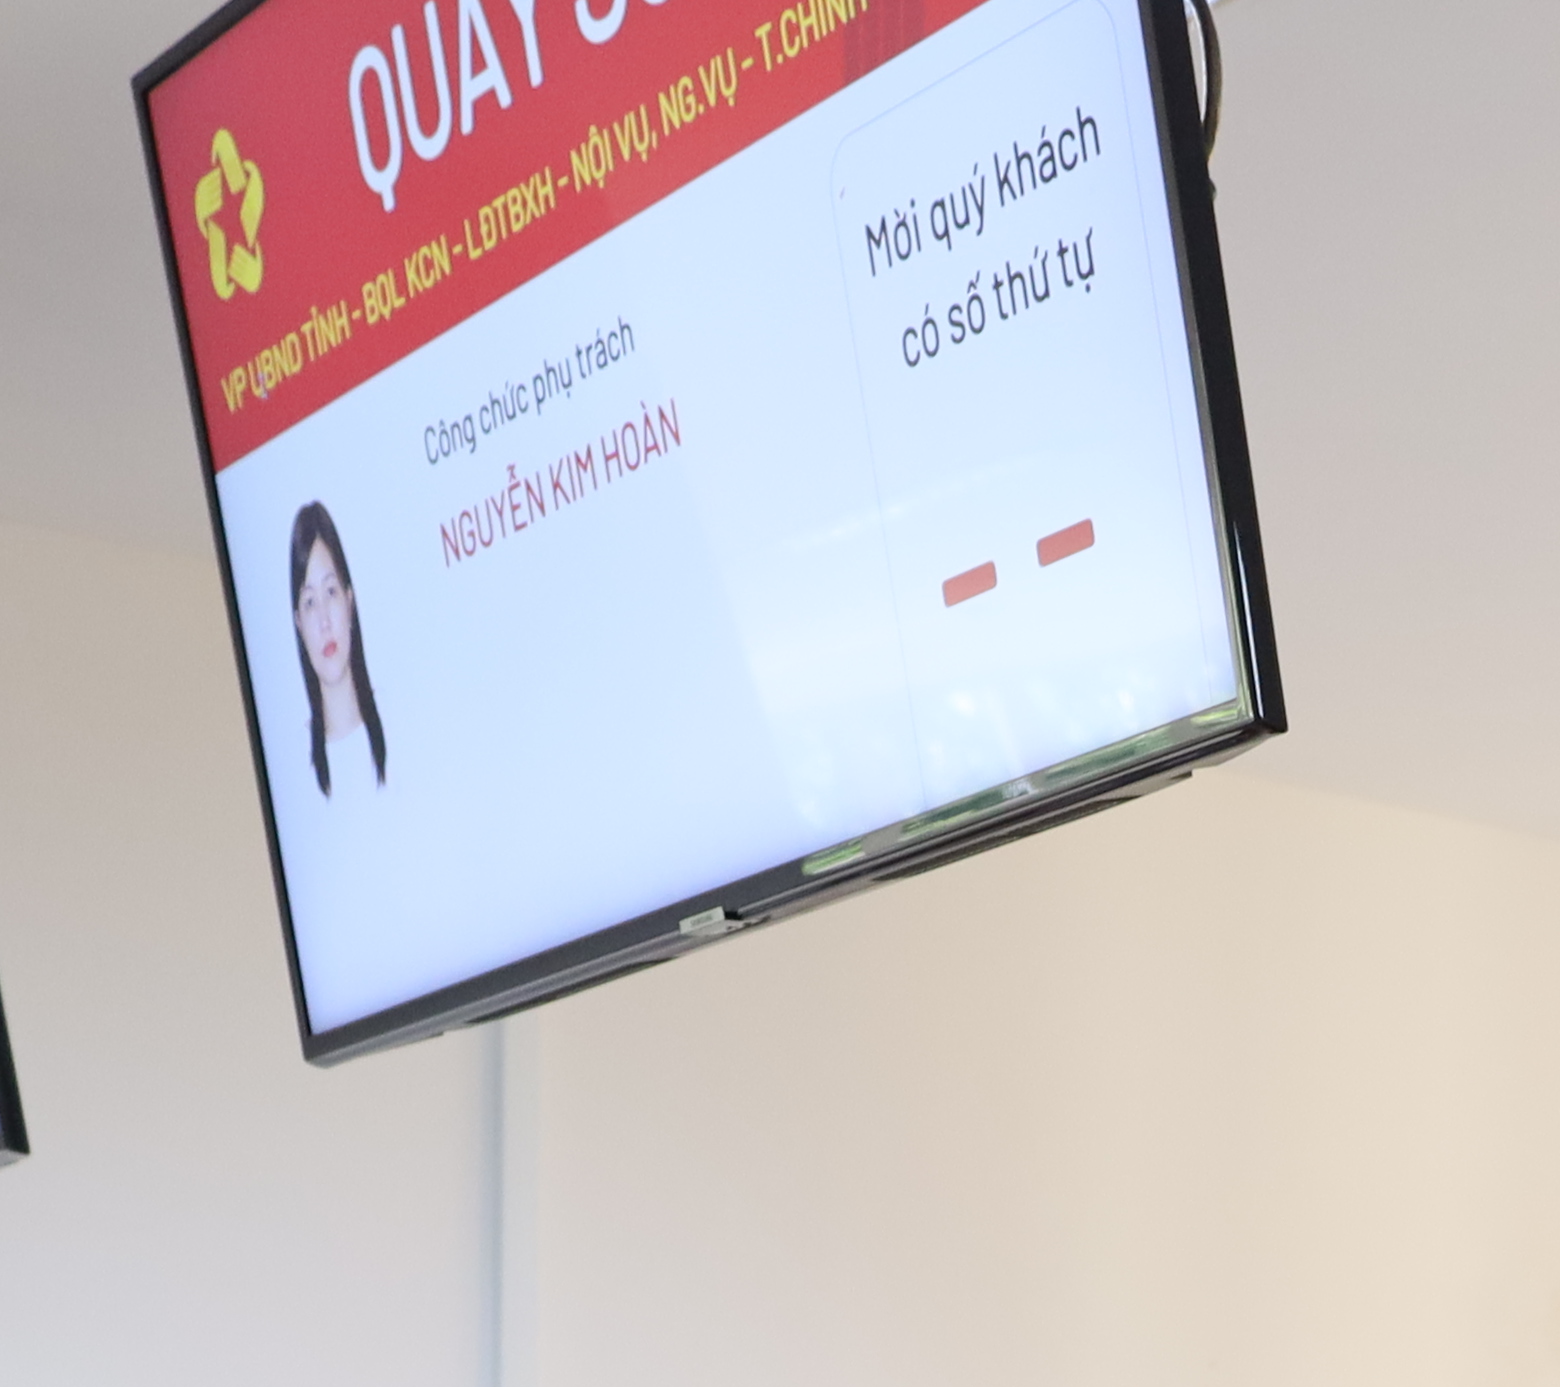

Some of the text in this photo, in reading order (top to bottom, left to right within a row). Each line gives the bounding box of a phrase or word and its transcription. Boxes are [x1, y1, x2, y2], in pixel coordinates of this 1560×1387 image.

[221, 366, 246, 414] VP
[247, 331, 302, 398] UBND
[300, 299, 351, 362] TỈNH
[362, 267, 406, 325] BQL
[404, 234, 452, 293] KCN
[463, 166, 556, 260] LĐTBXH
[570, 124, 614, 193] NỘI
[613, 104, 658, 162] VỤ,
[658, 47, 738, 136] NG.VỤ
[865, 105, 1101, 277] Mời quý khách
[902, 226, 1095, 367] có số thứ tự
[424, 315, 635, 466] Công chức phụ trách
[440, 398, 681, 567] NGUYỄN KIM HOÀN
